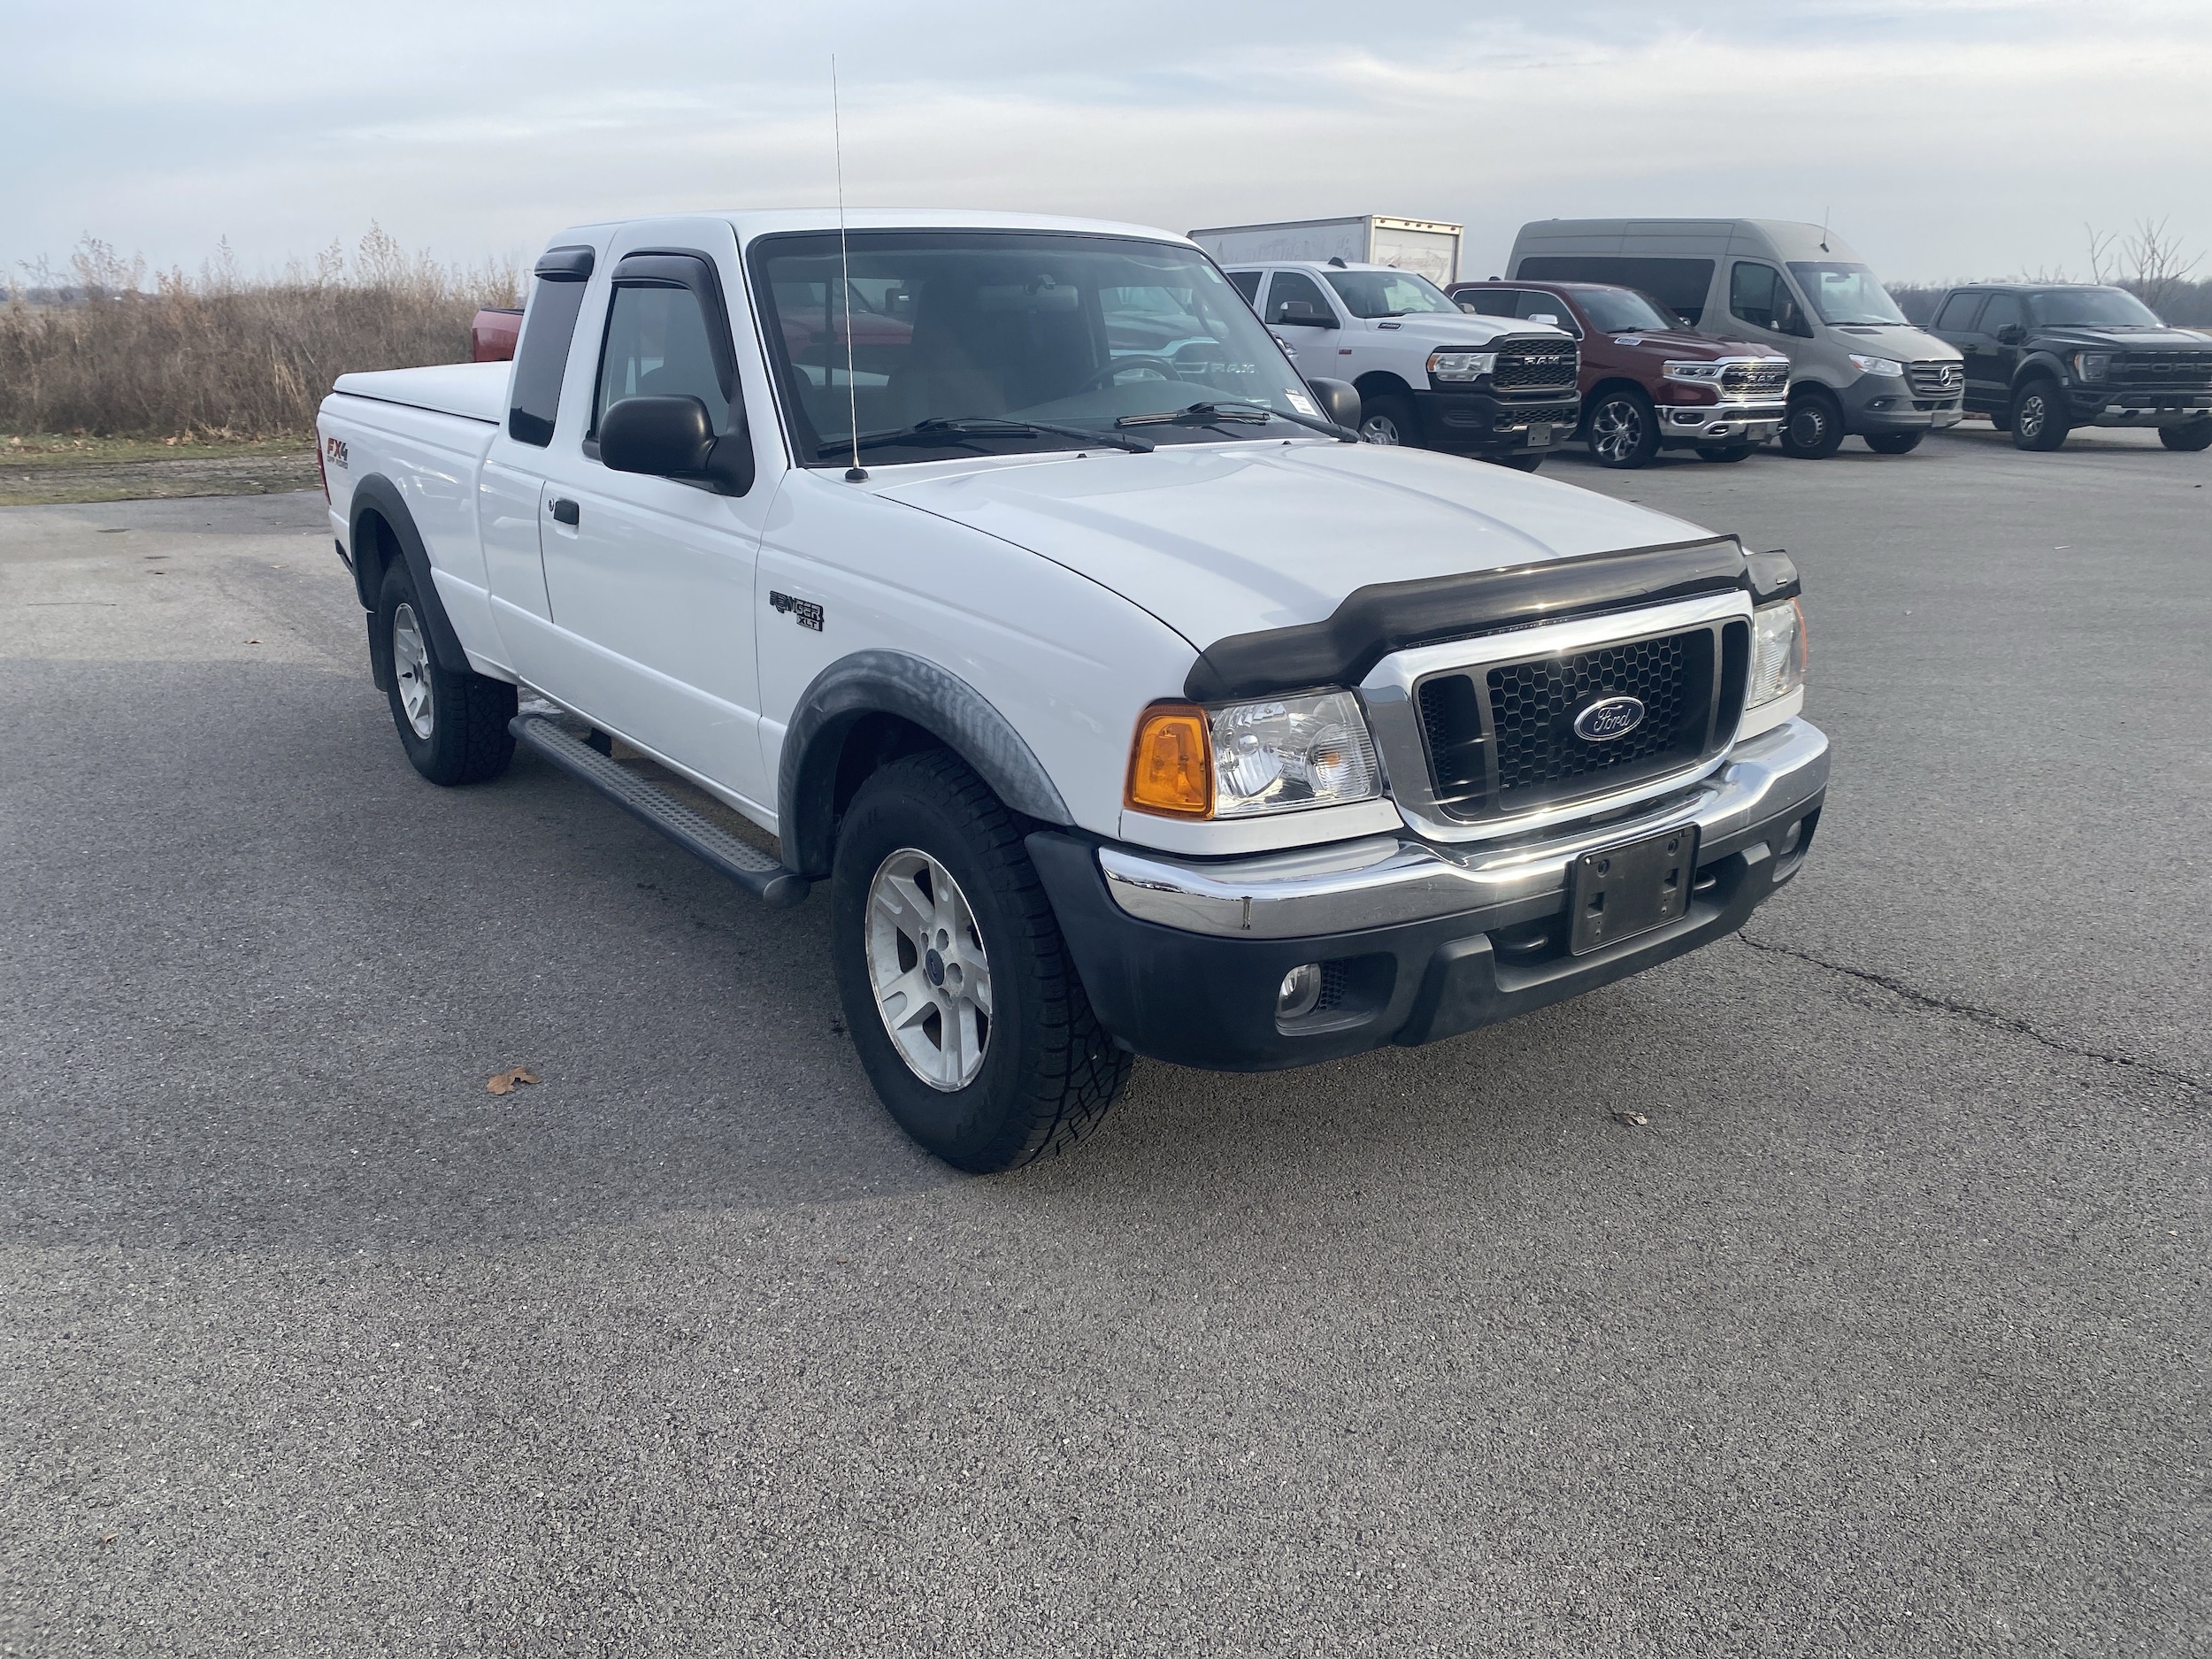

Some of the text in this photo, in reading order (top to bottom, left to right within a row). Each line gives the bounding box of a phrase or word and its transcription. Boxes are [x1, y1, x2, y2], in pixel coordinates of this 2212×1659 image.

[1524, 357, 1560, 365] RAM
[326, 437, 349, 462] FX4
[798, 616, 818, 629] XLT
[1593, 704, 1632, 733] Ford
